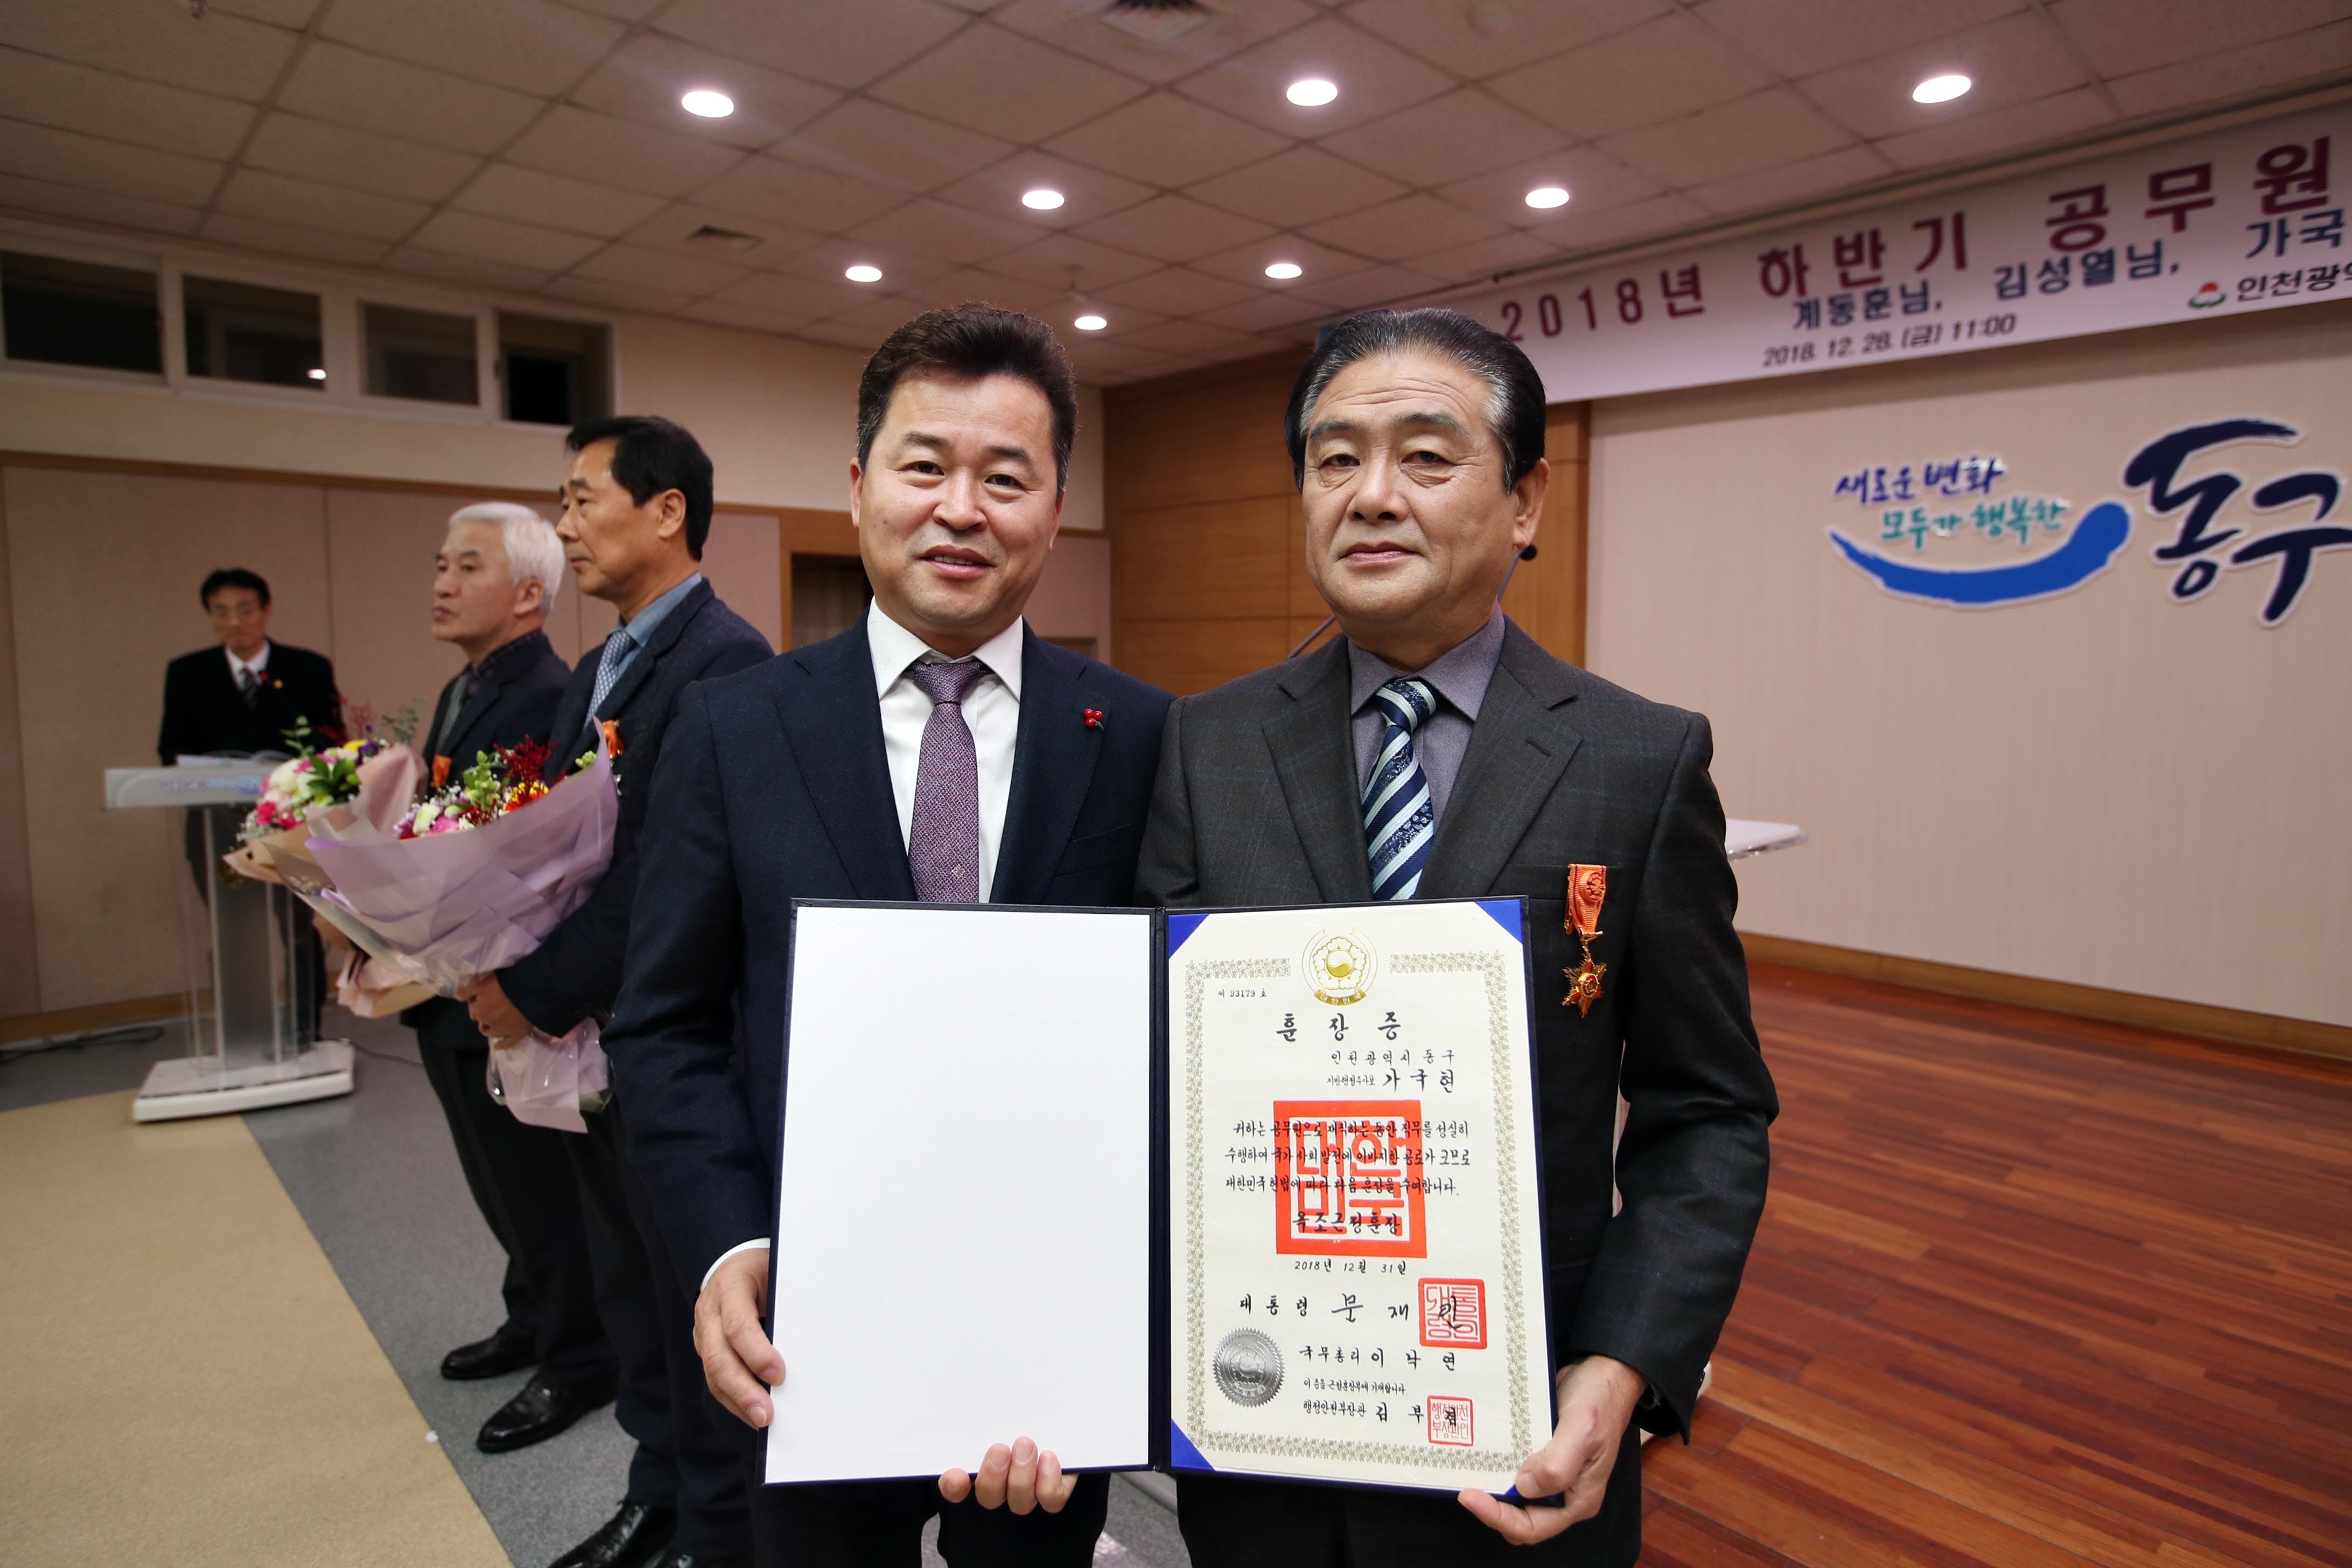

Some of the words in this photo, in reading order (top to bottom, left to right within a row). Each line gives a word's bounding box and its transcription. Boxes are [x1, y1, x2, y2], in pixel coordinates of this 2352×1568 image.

[1501, 263, 1706, 342] 2018년
[1758, 211, 1968, 299] 하반기
[2044, 136, 2331, 253] 공무원
[1951, 312, 2018, 341] 11:00
[1835, 465, 1916, 505] 새로운
[1923, 455, 2005, 496] 변화
[1880, 506, 1964, 550] 모두가
[1970, 496, 2069, 546] 행복한
[2124, 418, 2352, 622] 동구
[1233, 1119, 1266, 1138] 귀하는
[1270, 1119, 1322, 1138] 공무원으로
[1327, 1119, 1370, 1138] 재직하는
[1373, 1120, 1397, 1138] 동안
[1401, 1119, 1432, 1139] 직무를
[1436, 1120, 1468, 1139] 성실히
[1224, 1146, 1268, 1165] 수행하여
[1403, 1147, 1436, 1166] 공로가
[1225, 1174, 1265, 1193] 대한민국
[1269, 1174, 1301, 1193] 헌법에
[1239, 1293, 1308, 1317] 대통령
